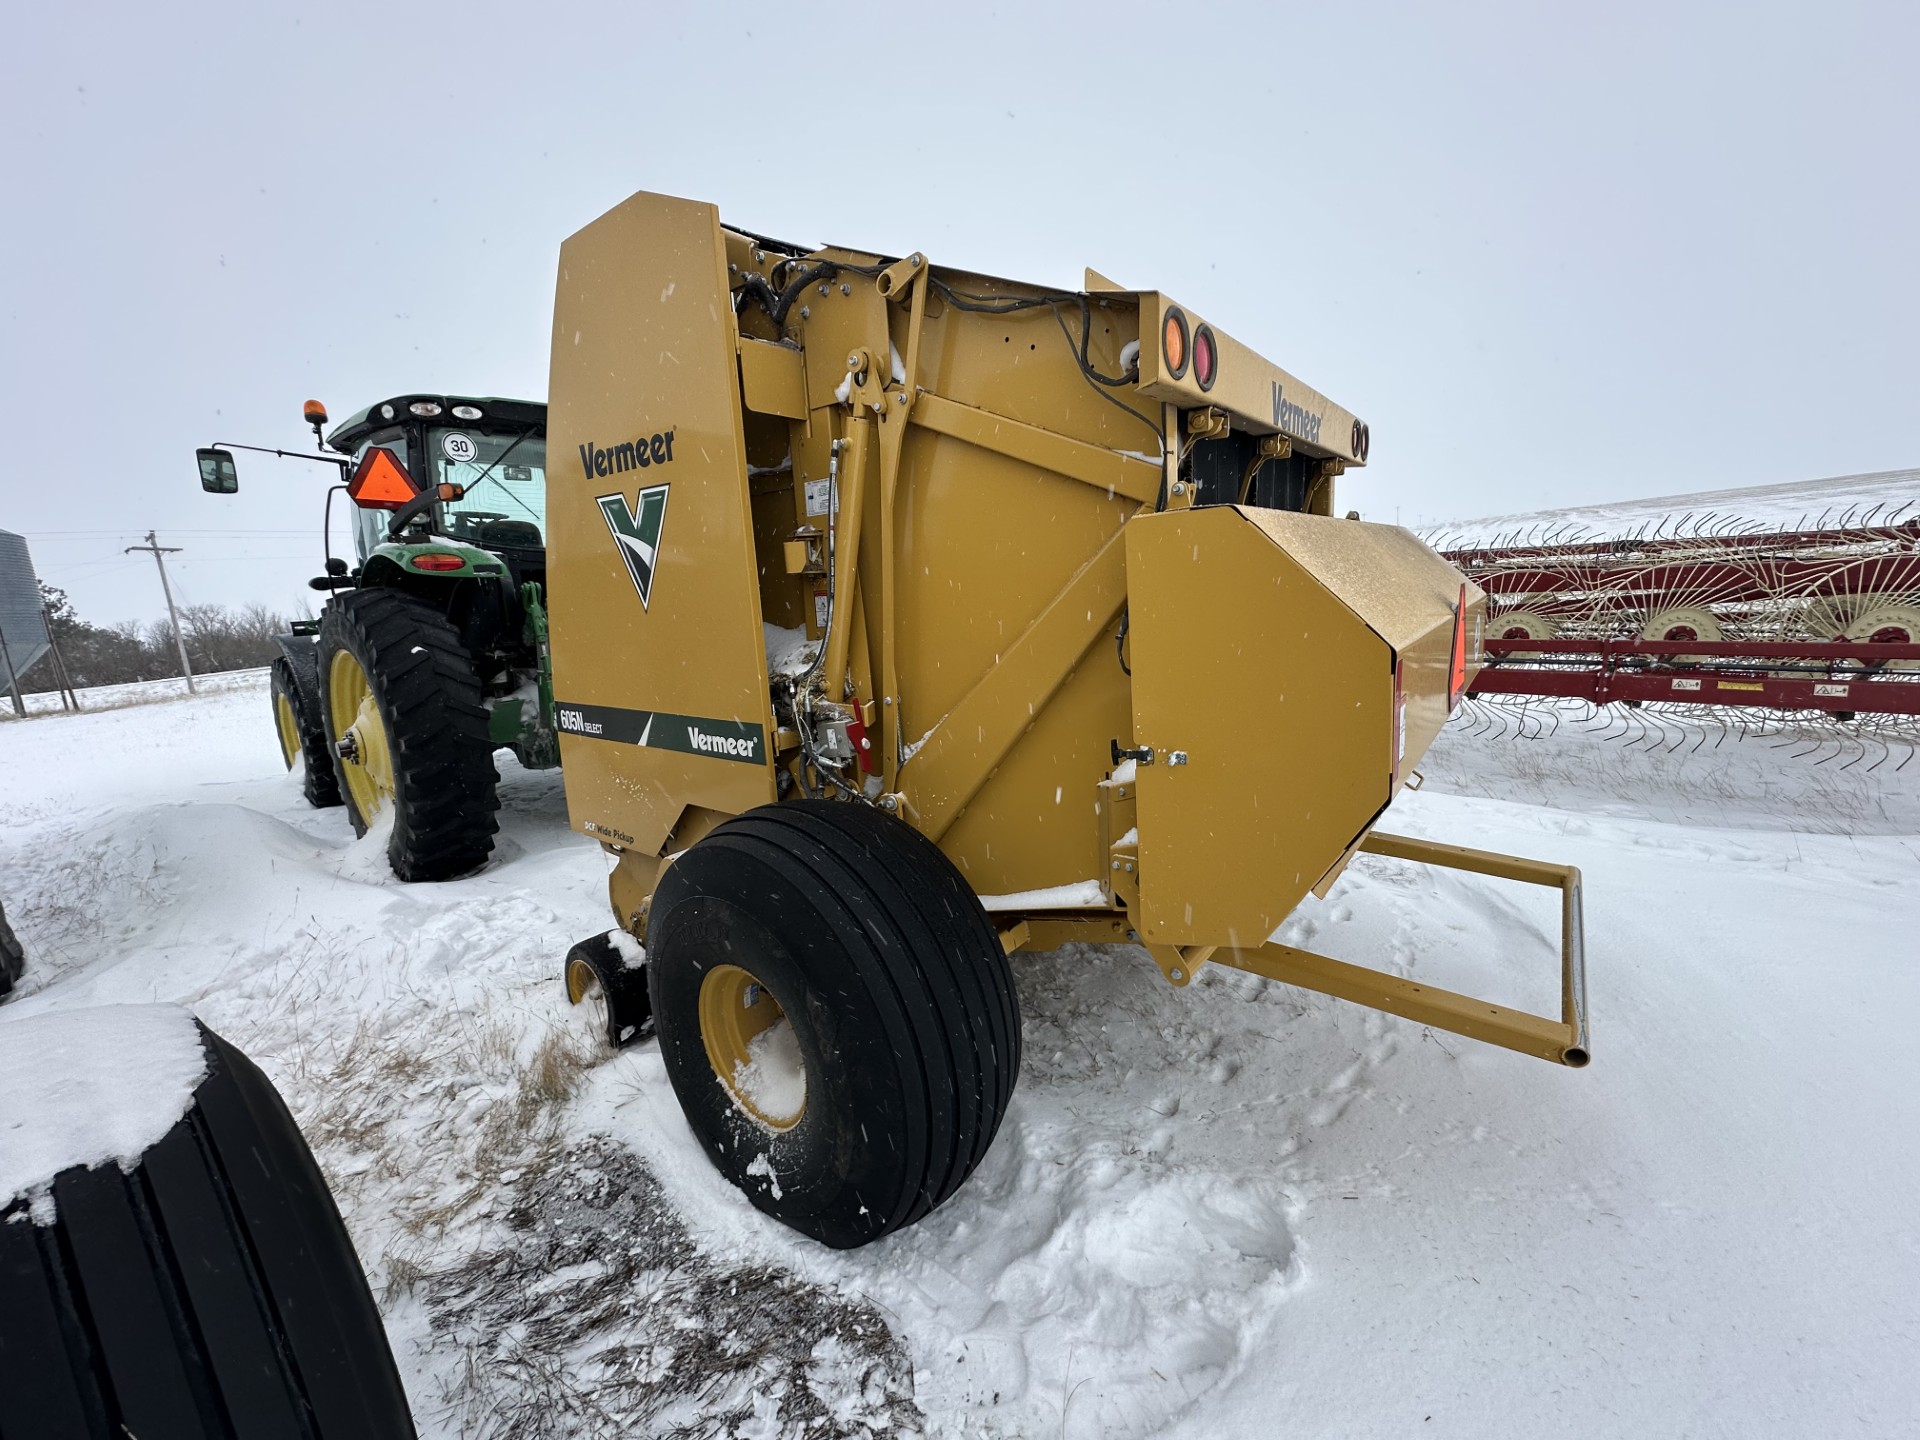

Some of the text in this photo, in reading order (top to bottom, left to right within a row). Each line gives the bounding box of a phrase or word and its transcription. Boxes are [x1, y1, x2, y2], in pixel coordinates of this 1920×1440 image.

[1271, 380, 1322, 444] Vermeer
[450, 439, 469, 453] 30
[578, 430, 675, 480] Vermeer
[560, 709, 603, 735] 605N SELECT
[687, 726, 755, 758] Vermeer
[597, 824, 612, 837] Wide
[613, 828, 635, 846] Pickup
